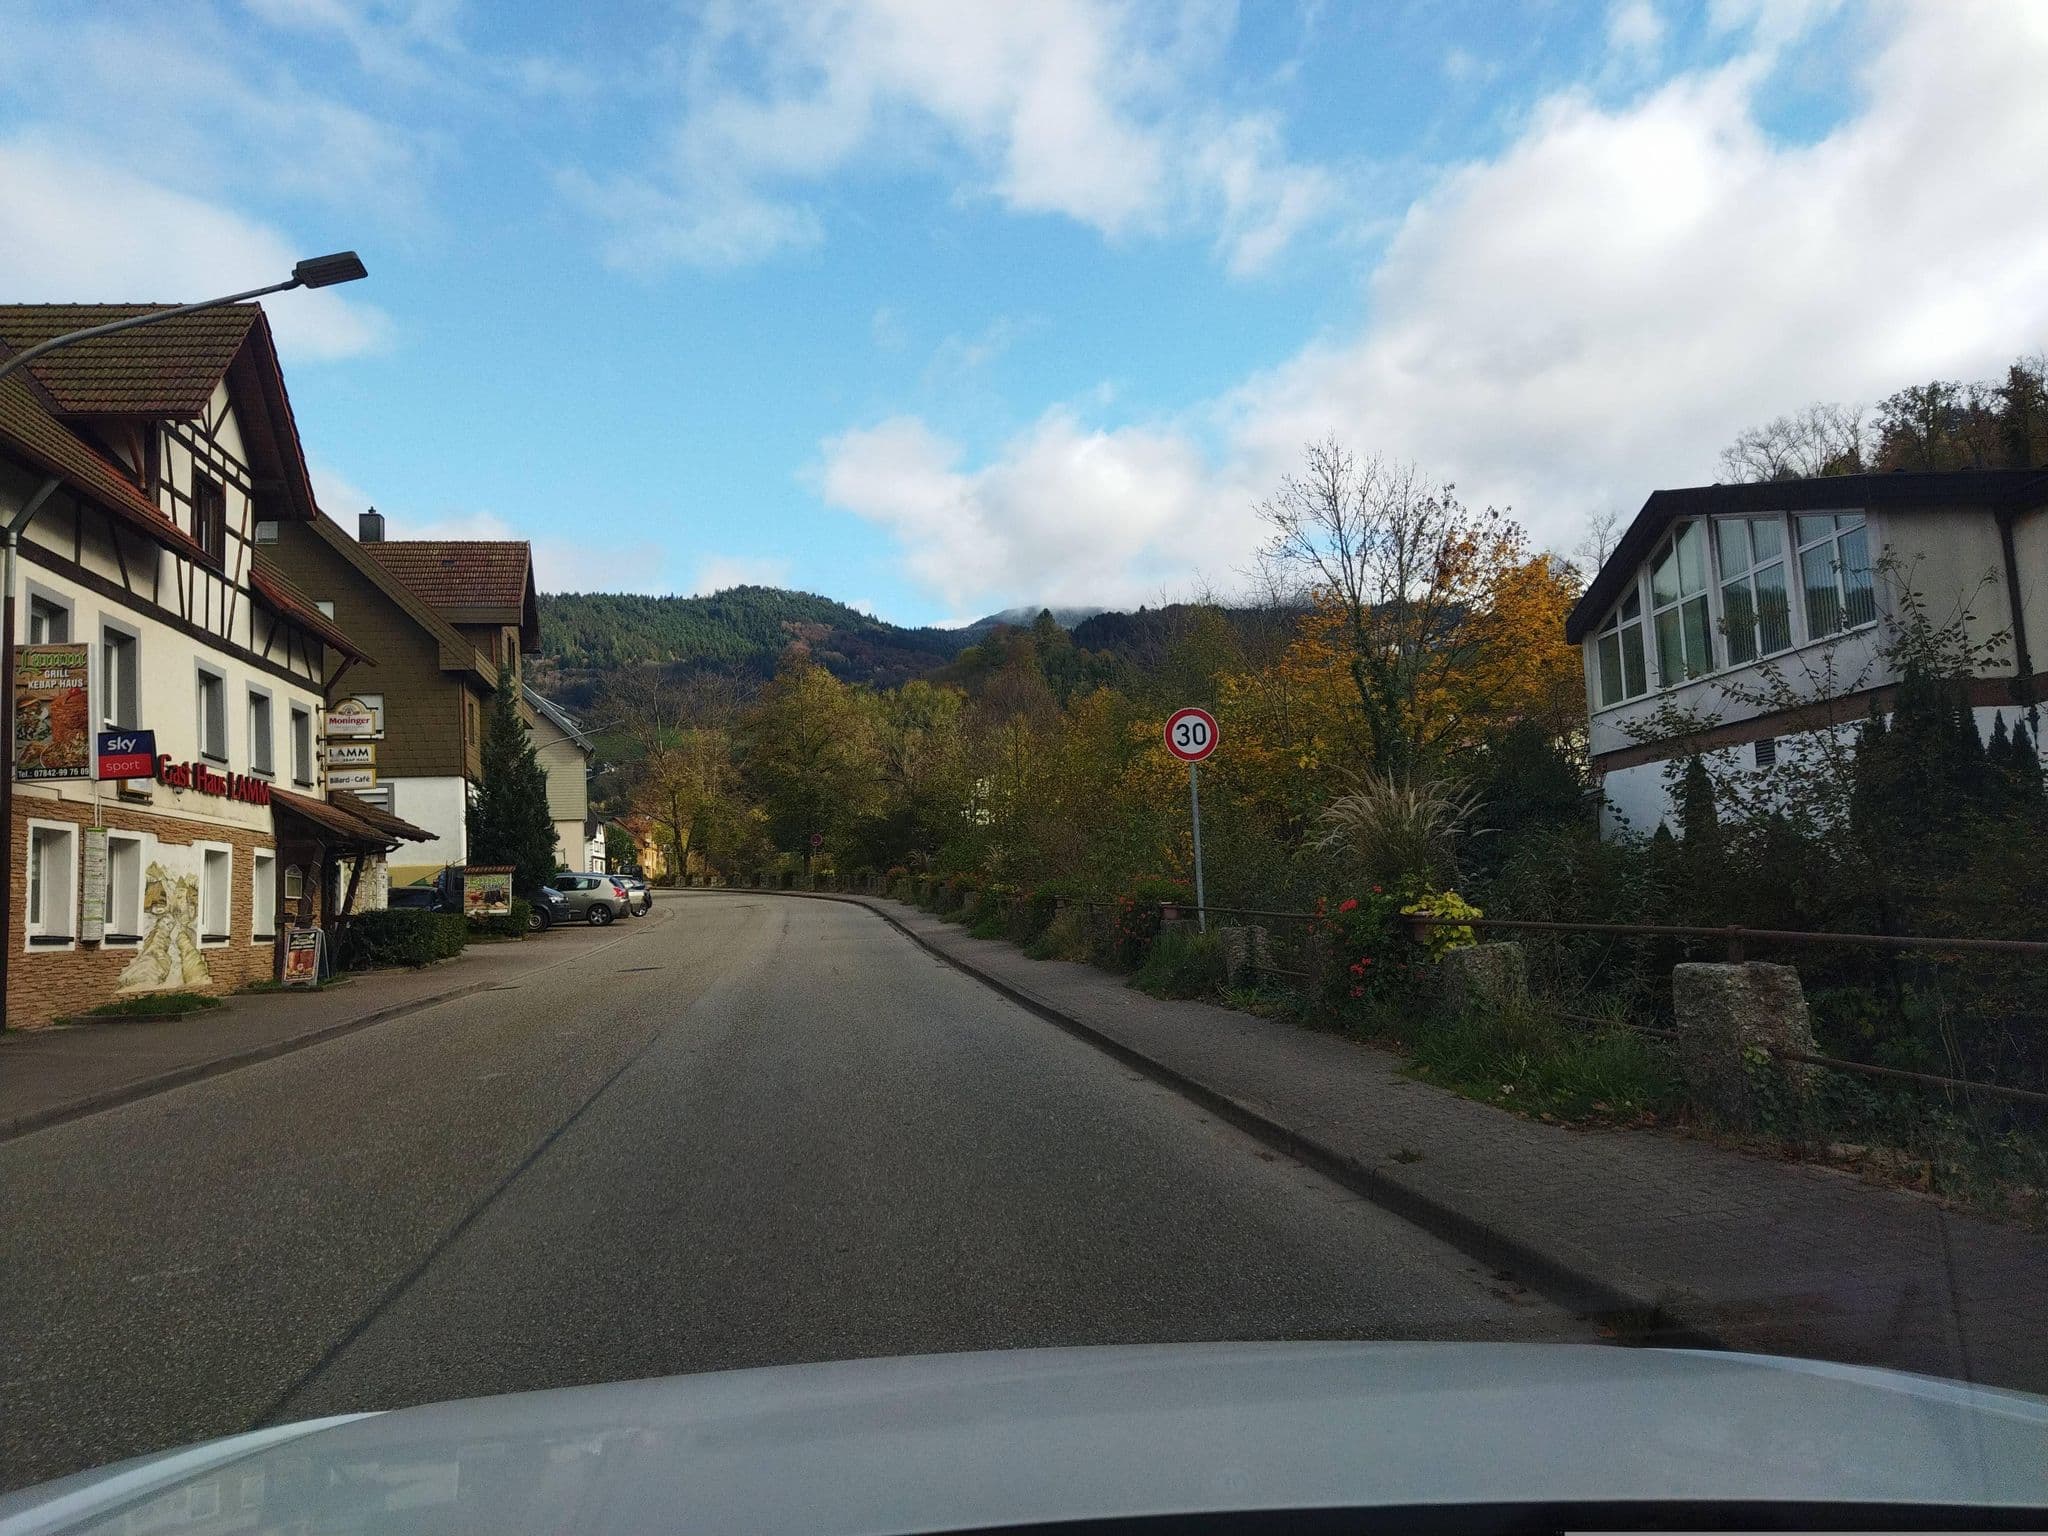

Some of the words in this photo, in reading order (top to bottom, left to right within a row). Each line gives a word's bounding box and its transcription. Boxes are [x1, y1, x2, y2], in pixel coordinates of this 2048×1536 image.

[44, 669, 70, 678] GRILL
[28, 680, 57, 689] KEBAP
[59, 679, 83, 688] HAUS
[329, 716, 370, 725] Moninger
[1176, 722, 1206, 746] 30
[107, 736, 136, 752] sky
[329, 748, 369, 757] LAMM
[106, 761, 140, 773] sport
[192, 762, 227, 797] Haus
[227, 771, 271, 805] LAMM
[354, 775, 370, 783] Café
